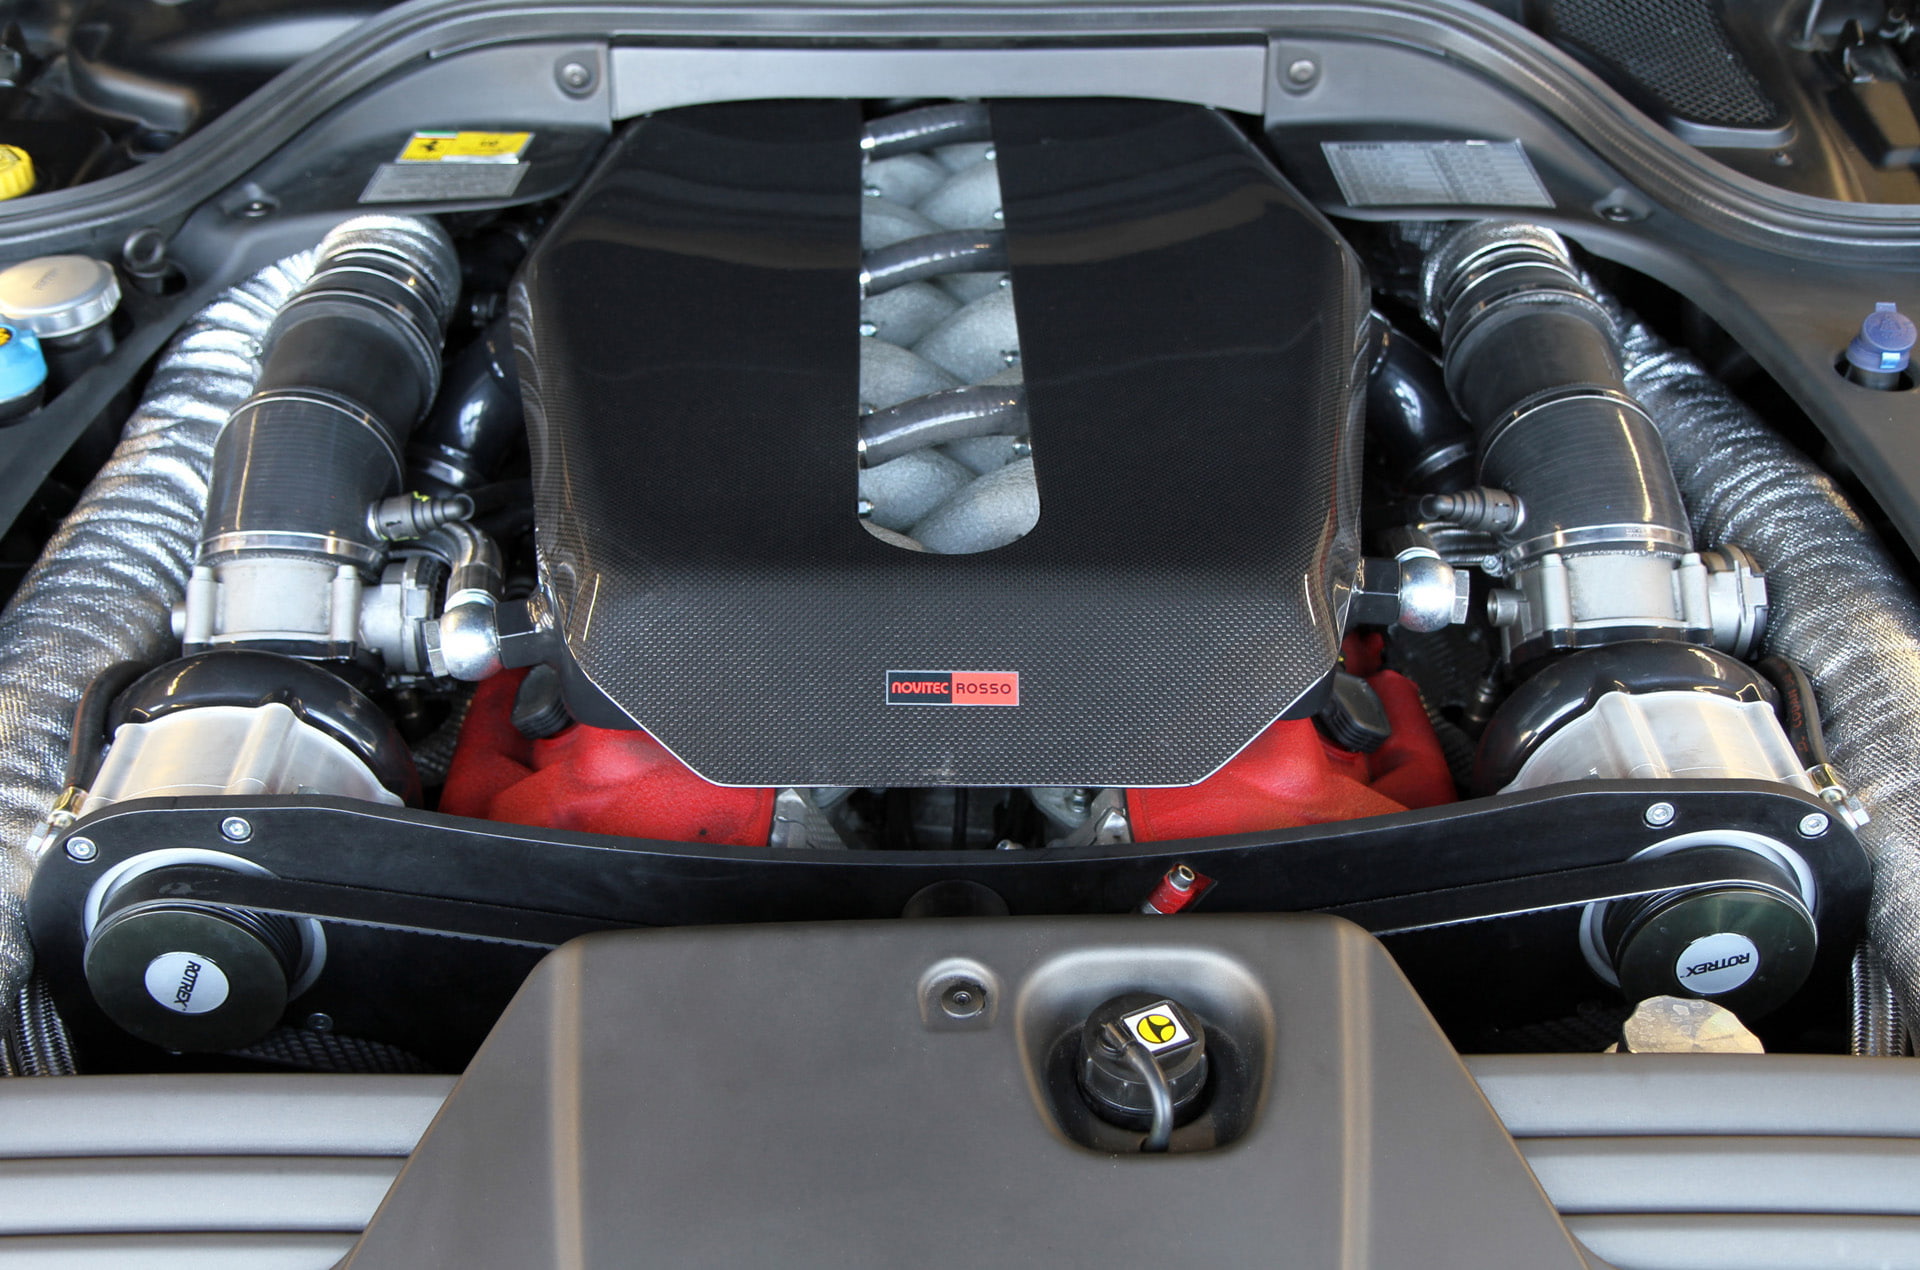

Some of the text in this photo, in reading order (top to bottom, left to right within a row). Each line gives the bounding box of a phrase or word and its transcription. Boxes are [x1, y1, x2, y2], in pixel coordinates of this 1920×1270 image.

[891, 681, 1012, 695] NOVITEC ROSSO
[1685, 952, 1750, 978] ROTREX
[173, 960, 202, 1008] ROTREX
